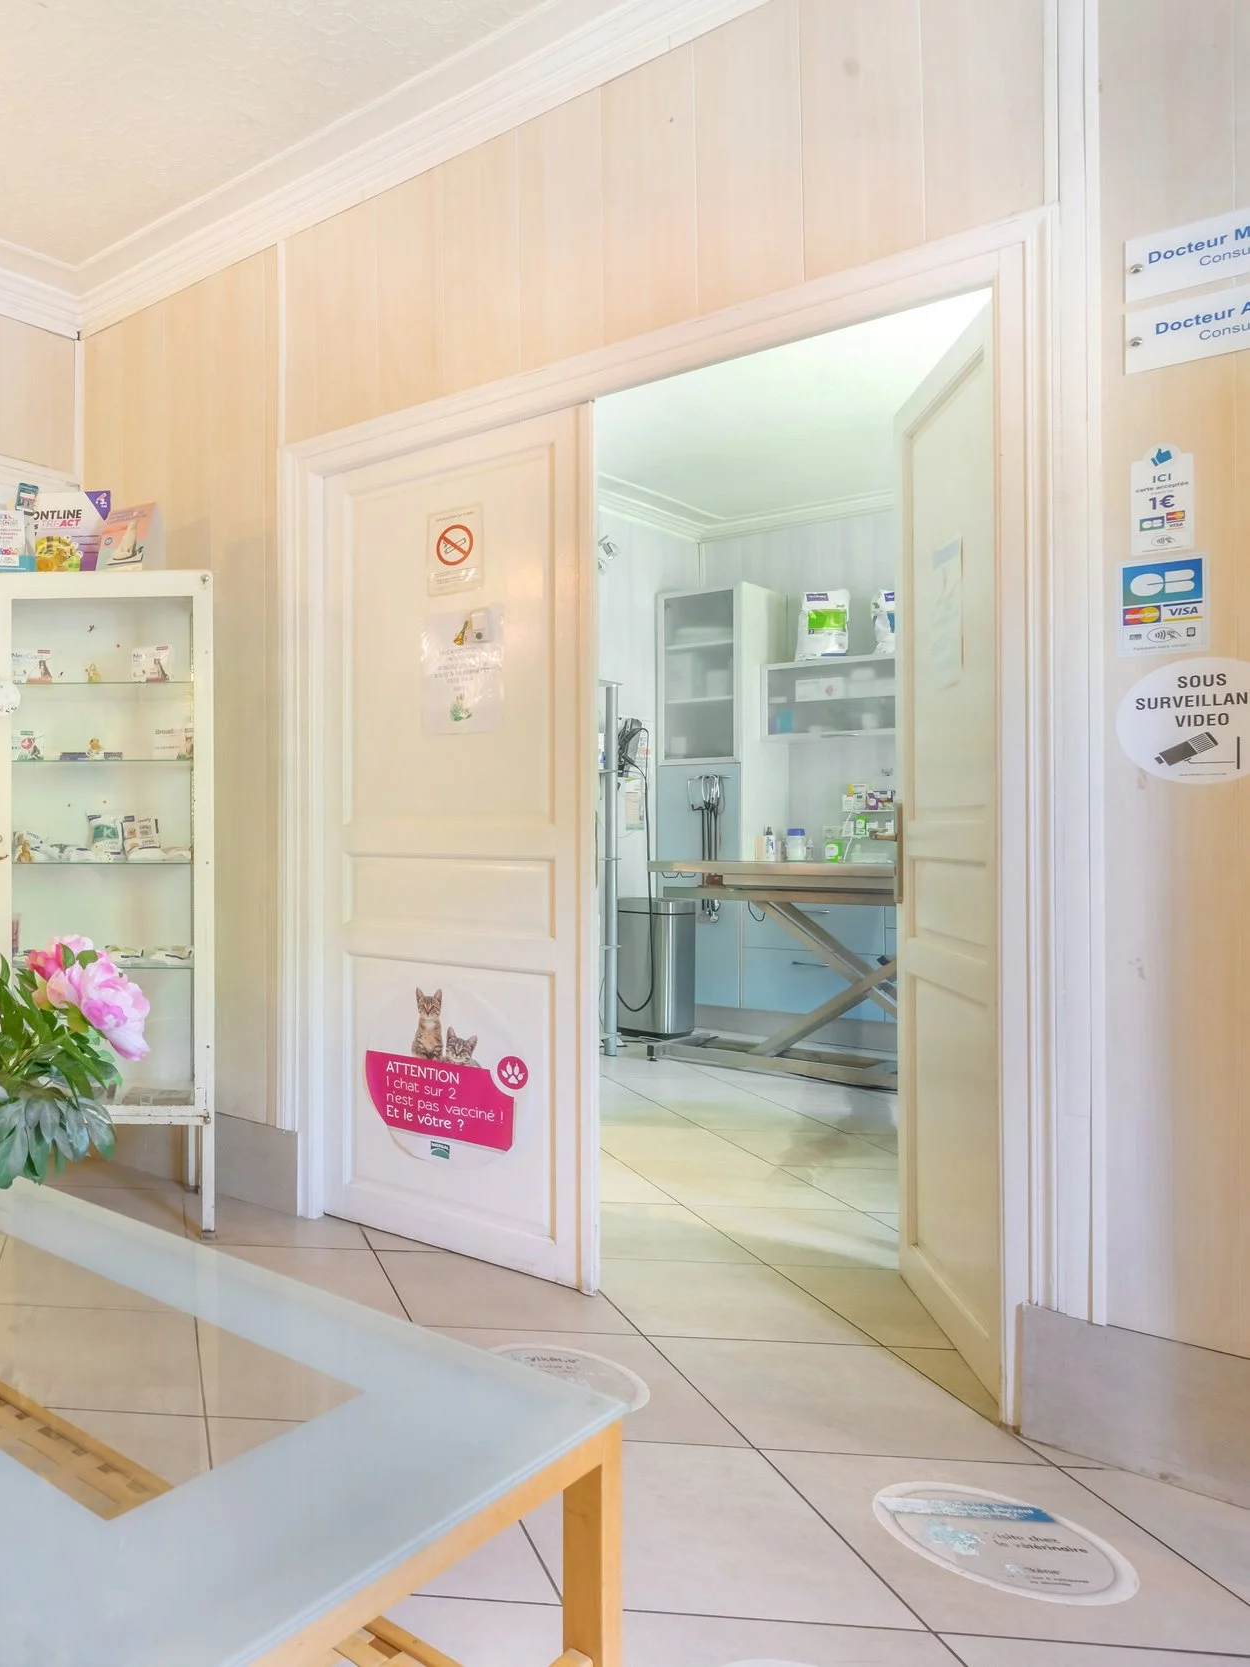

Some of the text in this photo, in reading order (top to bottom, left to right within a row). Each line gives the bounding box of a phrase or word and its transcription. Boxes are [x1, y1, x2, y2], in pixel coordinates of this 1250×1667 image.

[1148, 234, 1228, 264] Docteur
[1155, 308, 1236, 335] Docteur
[1152, 473, 1172, 483] ICI
[1136, 481, 1189, 494] carte acceptée
[1148, 494, 1175, 510] 1€
[34, 510, 82, 520] ONTLINE
[1169, 606, 1198, 616] VISA
[1178, 673, 1227, 688] SOUS
[1136, 692, 1248, 710] SURVEILLAN
[1175, 713, 1230, 727] VIDEO
[386, 1061, 459, 1085] ATTENTION
[394, 1078, 419, 1093] chat
[424, 1086, 443, 1097] sur
[449, 1088, 456, 1099] 2
[386, 1090, 413, 1106] n'est
[417, 1100, 439, 1112] pas
[445, 1104, 494, 1122] vacciné
[386, 1105, 464, 1131] Et le vôtre ?
[1028, 1535, 1060, 1543] chez
